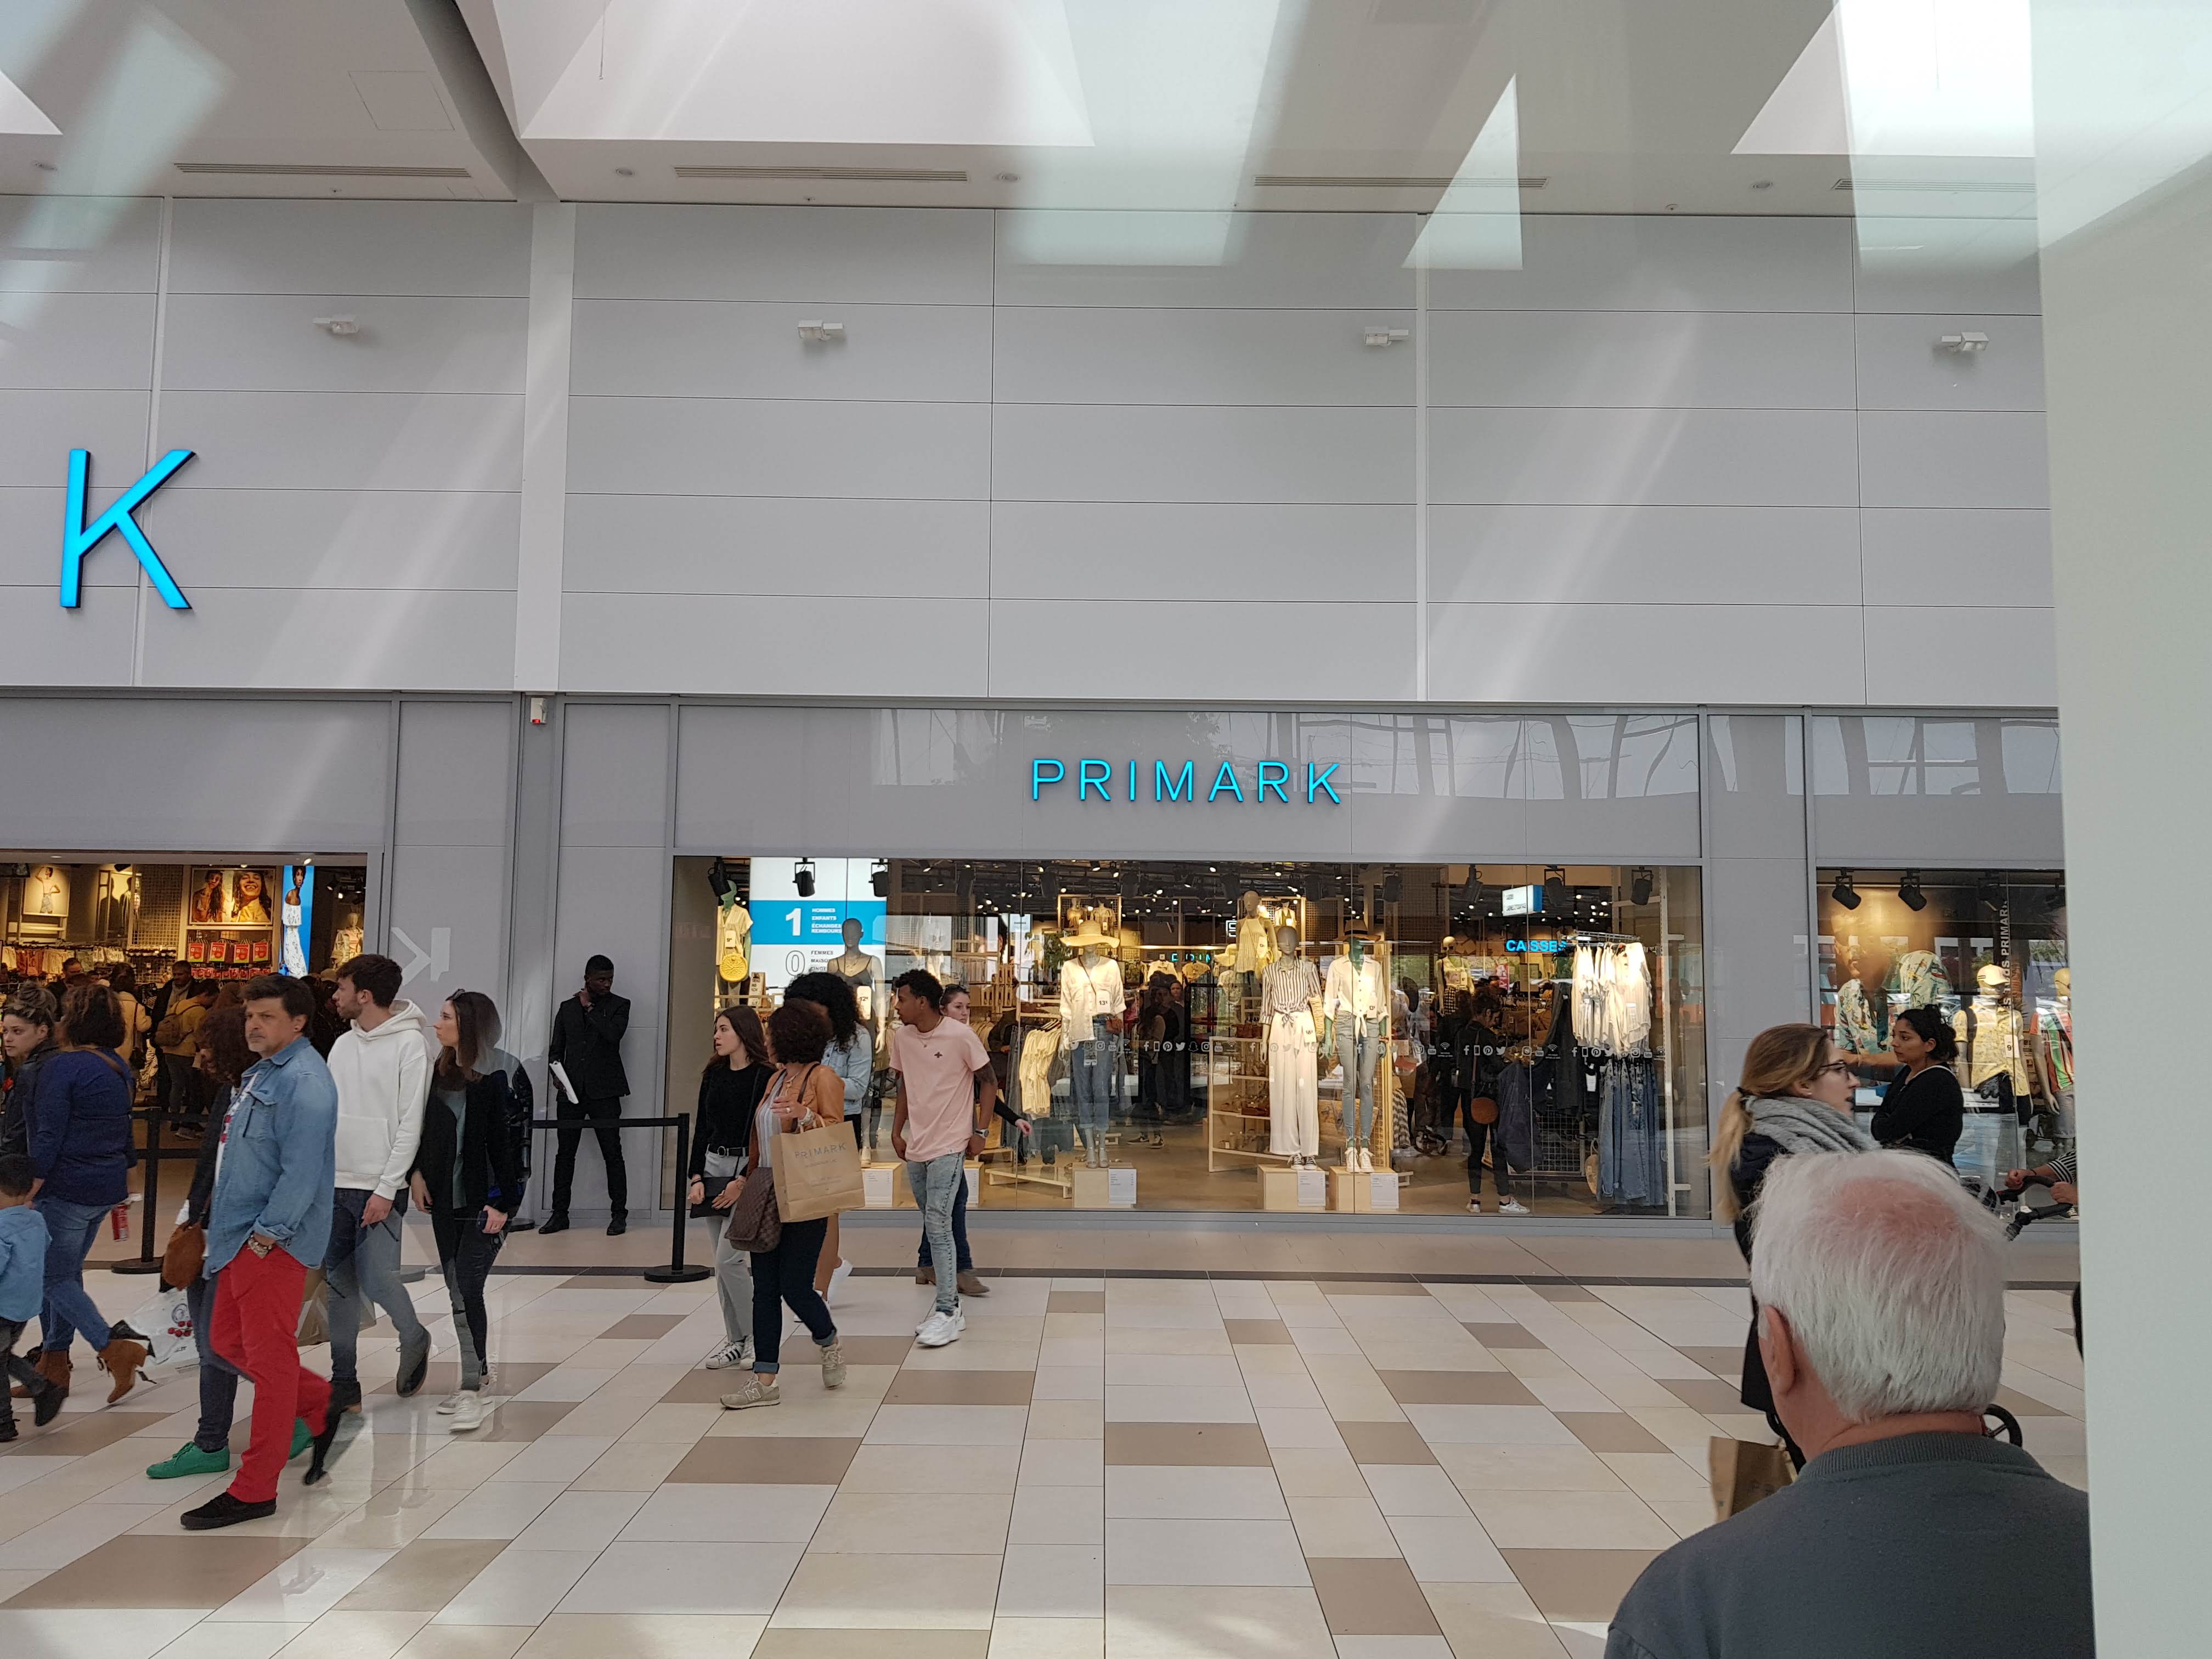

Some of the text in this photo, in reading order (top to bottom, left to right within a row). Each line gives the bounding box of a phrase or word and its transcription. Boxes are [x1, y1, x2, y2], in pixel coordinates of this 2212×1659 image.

[60, 448, 196, 609] K
[1032, 759, 1341, 803] PRIMARK
[786, 908, 802, 936] 1
[786, 951, 805, 977] 0
[795, 1142, 847, 1159] PRIMARK
